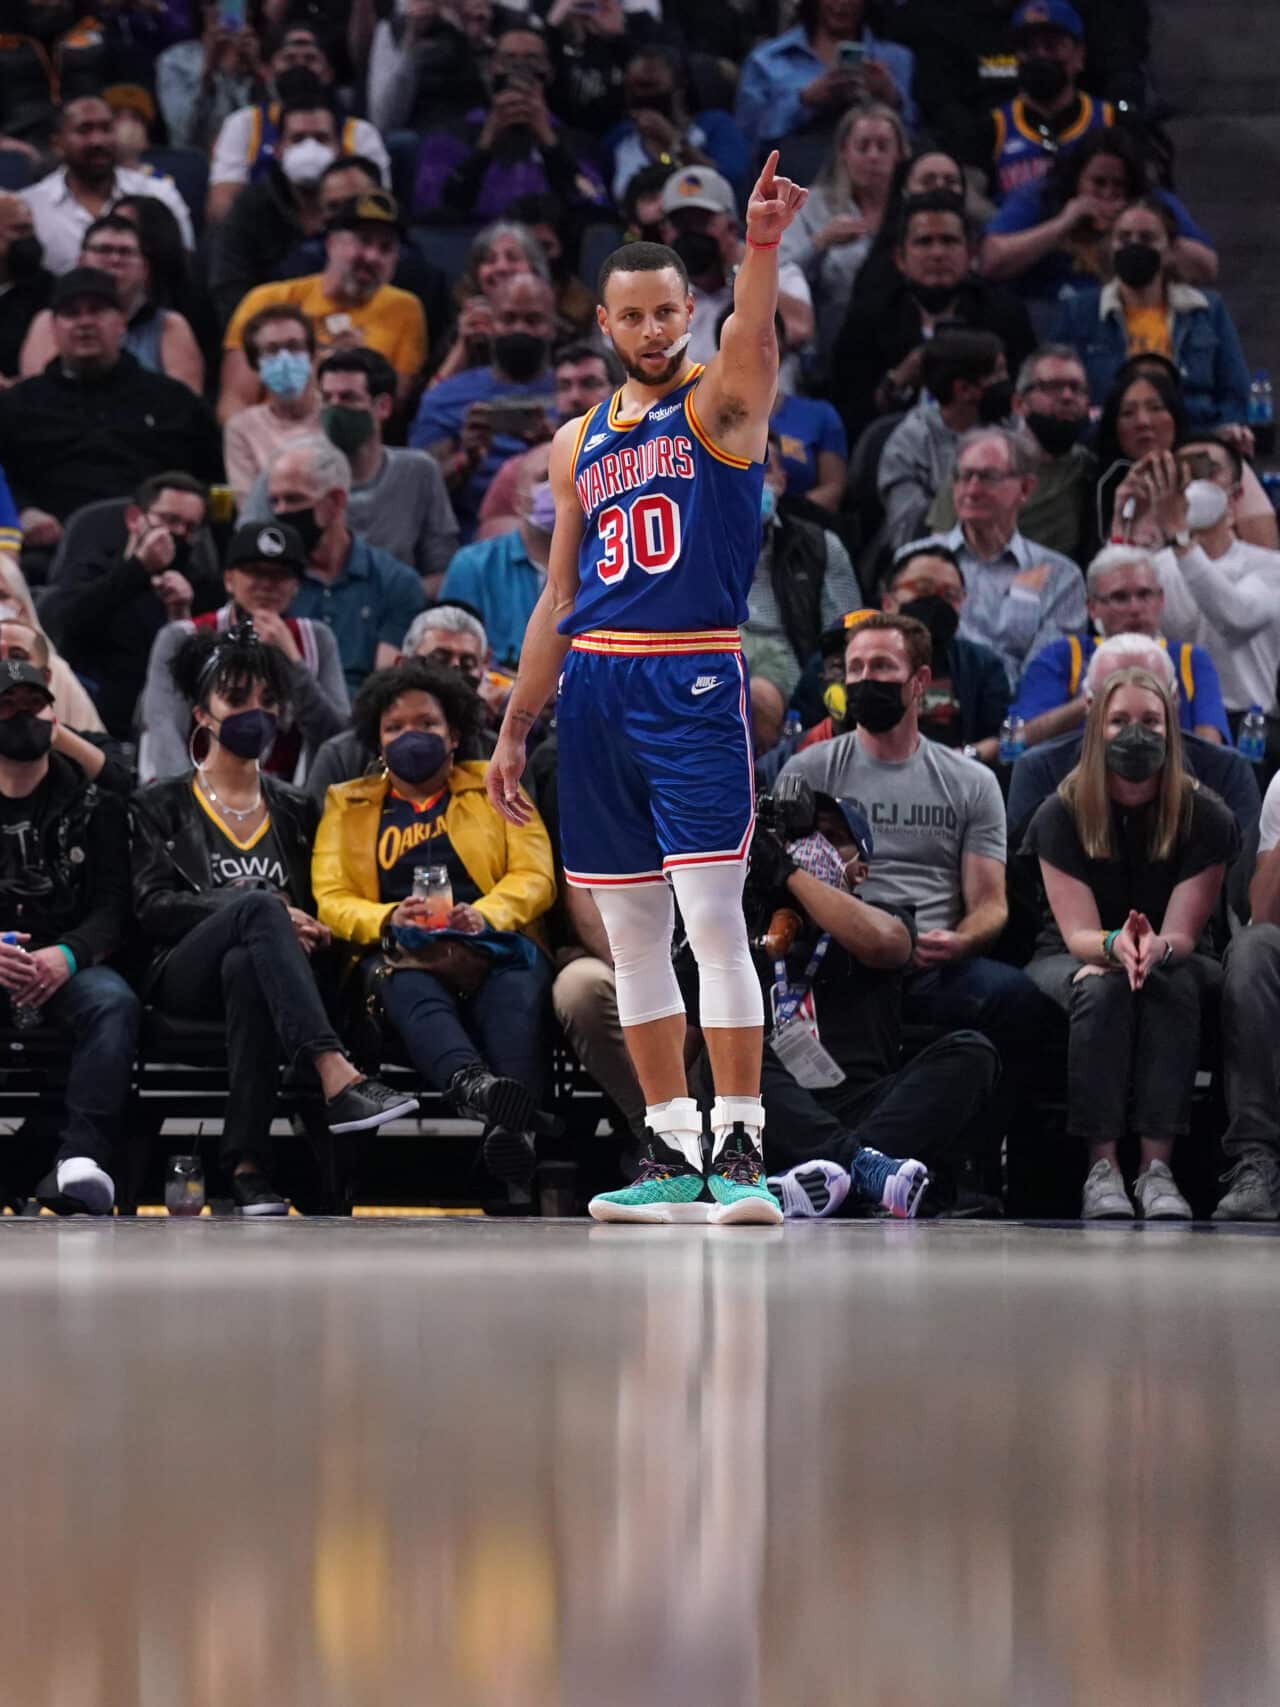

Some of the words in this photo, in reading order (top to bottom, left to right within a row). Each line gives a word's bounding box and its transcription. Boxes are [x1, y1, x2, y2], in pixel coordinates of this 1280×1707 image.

[648, 403, 682, 421] Rakuten
[576, 435, 695, 519] WARRIORS
[597, 493, 682, 586] 30
[871, 803, 898, 825] CJ
[903, 804, 957, 830] JUDO
